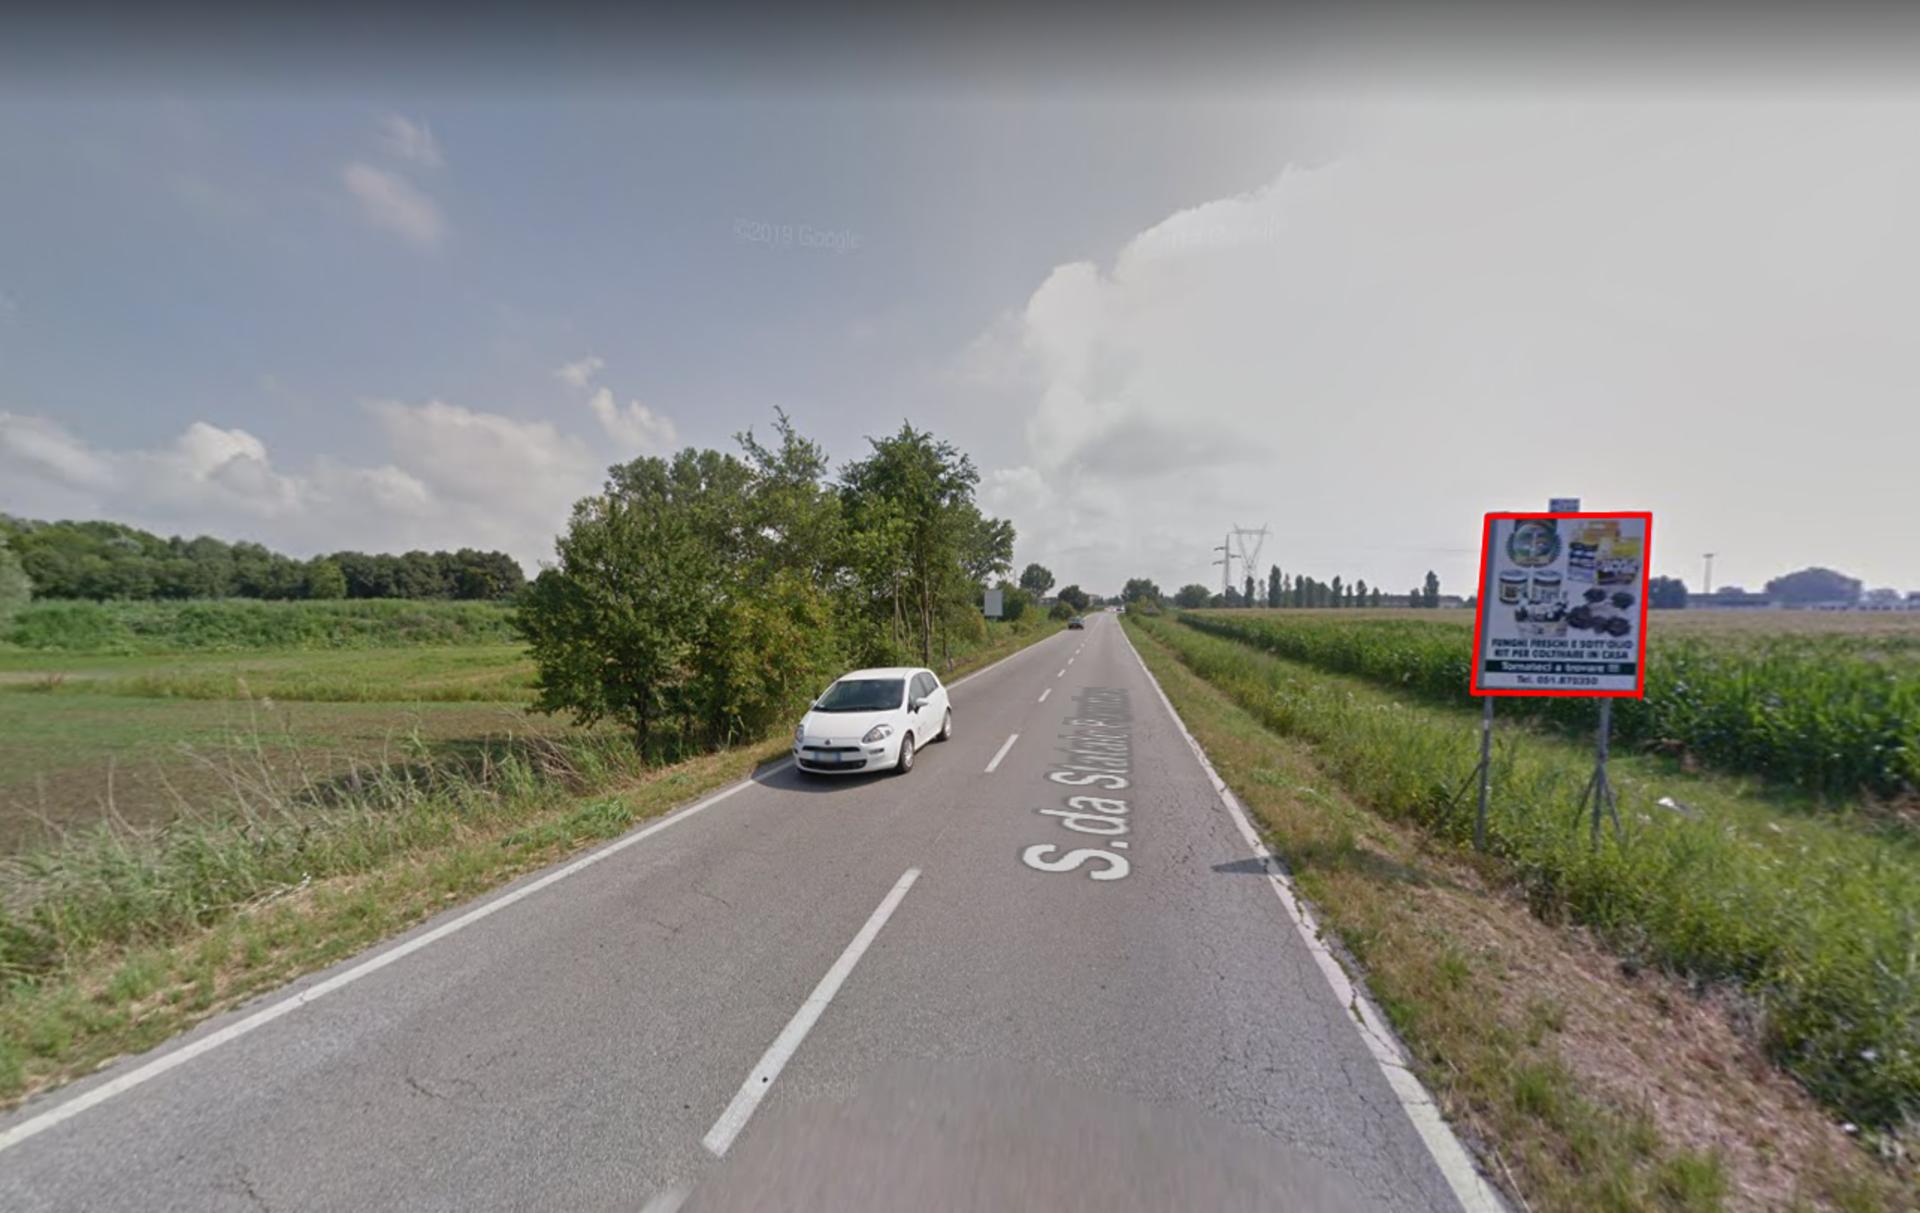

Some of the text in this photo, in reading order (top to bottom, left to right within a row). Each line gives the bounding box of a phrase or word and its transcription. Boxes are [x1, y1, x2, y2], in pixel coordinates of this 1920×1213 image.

[1530, 639, 1568, 648] FRESCHI
[1512, 649, 1529, 658] PER
[1602, 651, 1628, 659] CASA
